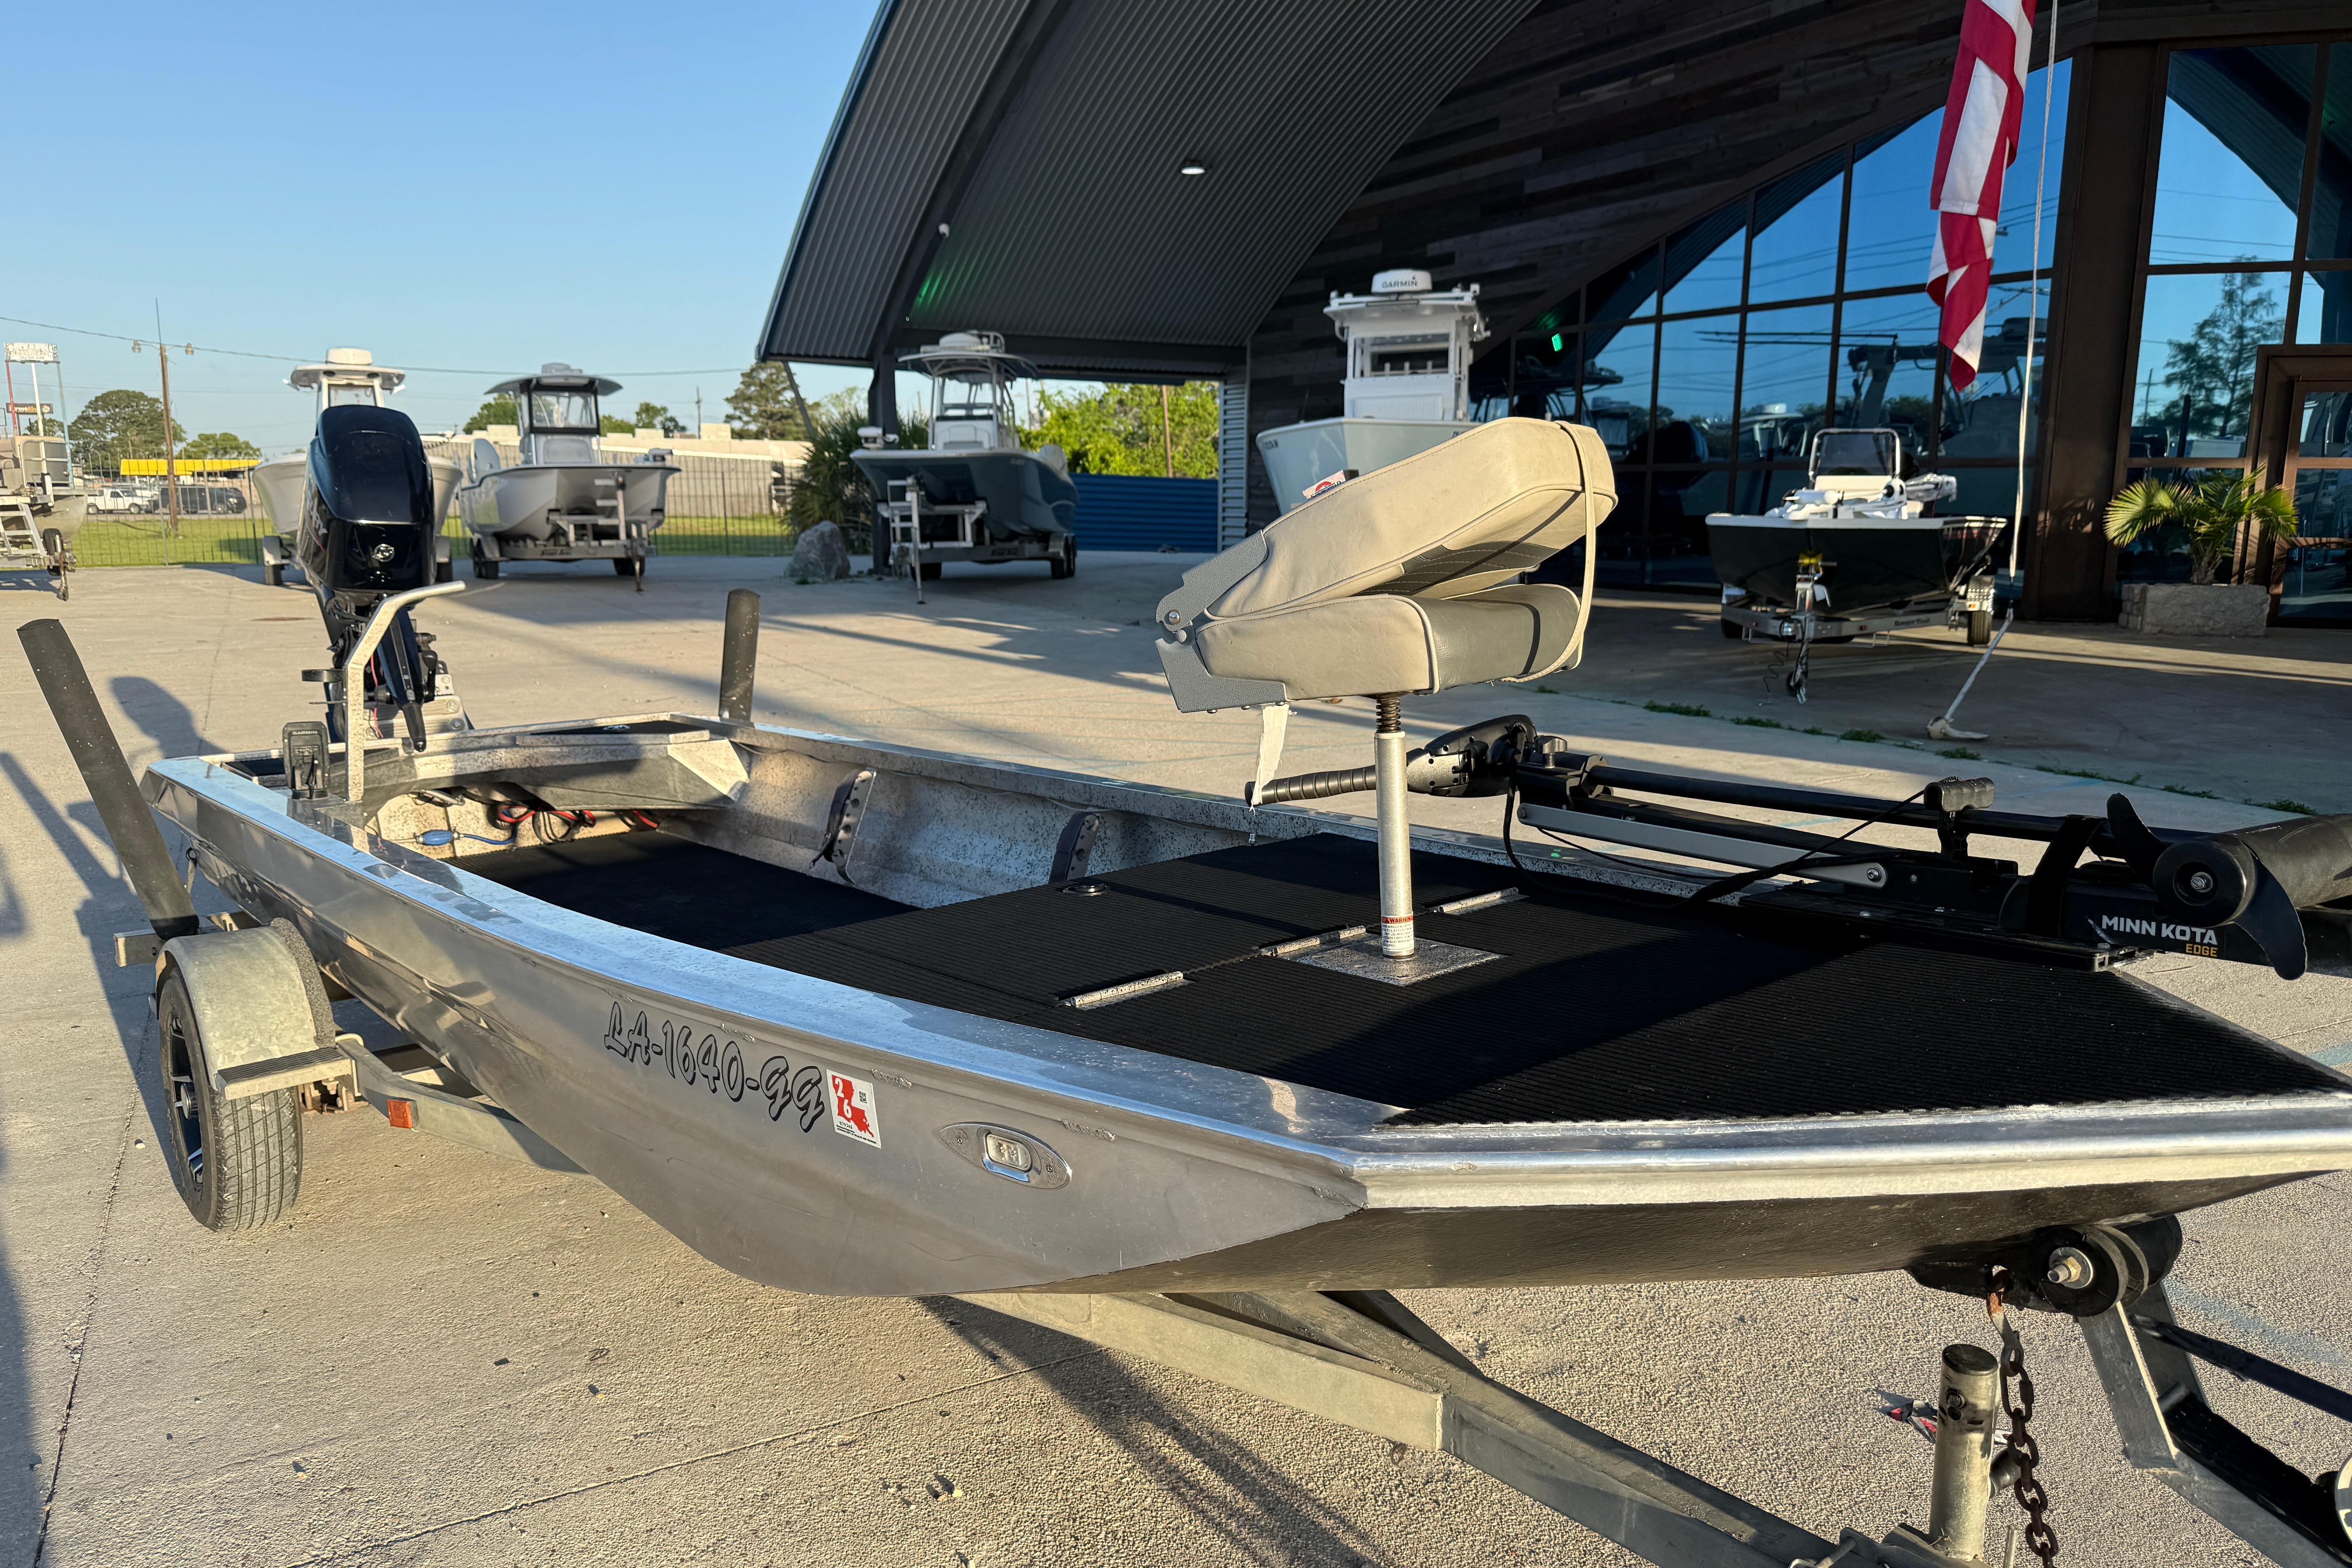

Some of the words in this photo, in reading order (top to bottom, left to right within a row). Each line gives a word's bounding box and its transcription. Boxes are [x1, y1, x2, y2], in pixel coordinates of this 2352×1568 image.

[1381, 280, 1417, 288] GARMIN
[2102, 915, 2156, 936] MINN
[2161, 923, 2217, 945] KOTA
[2186, 943, 2218, 957] EDGE
